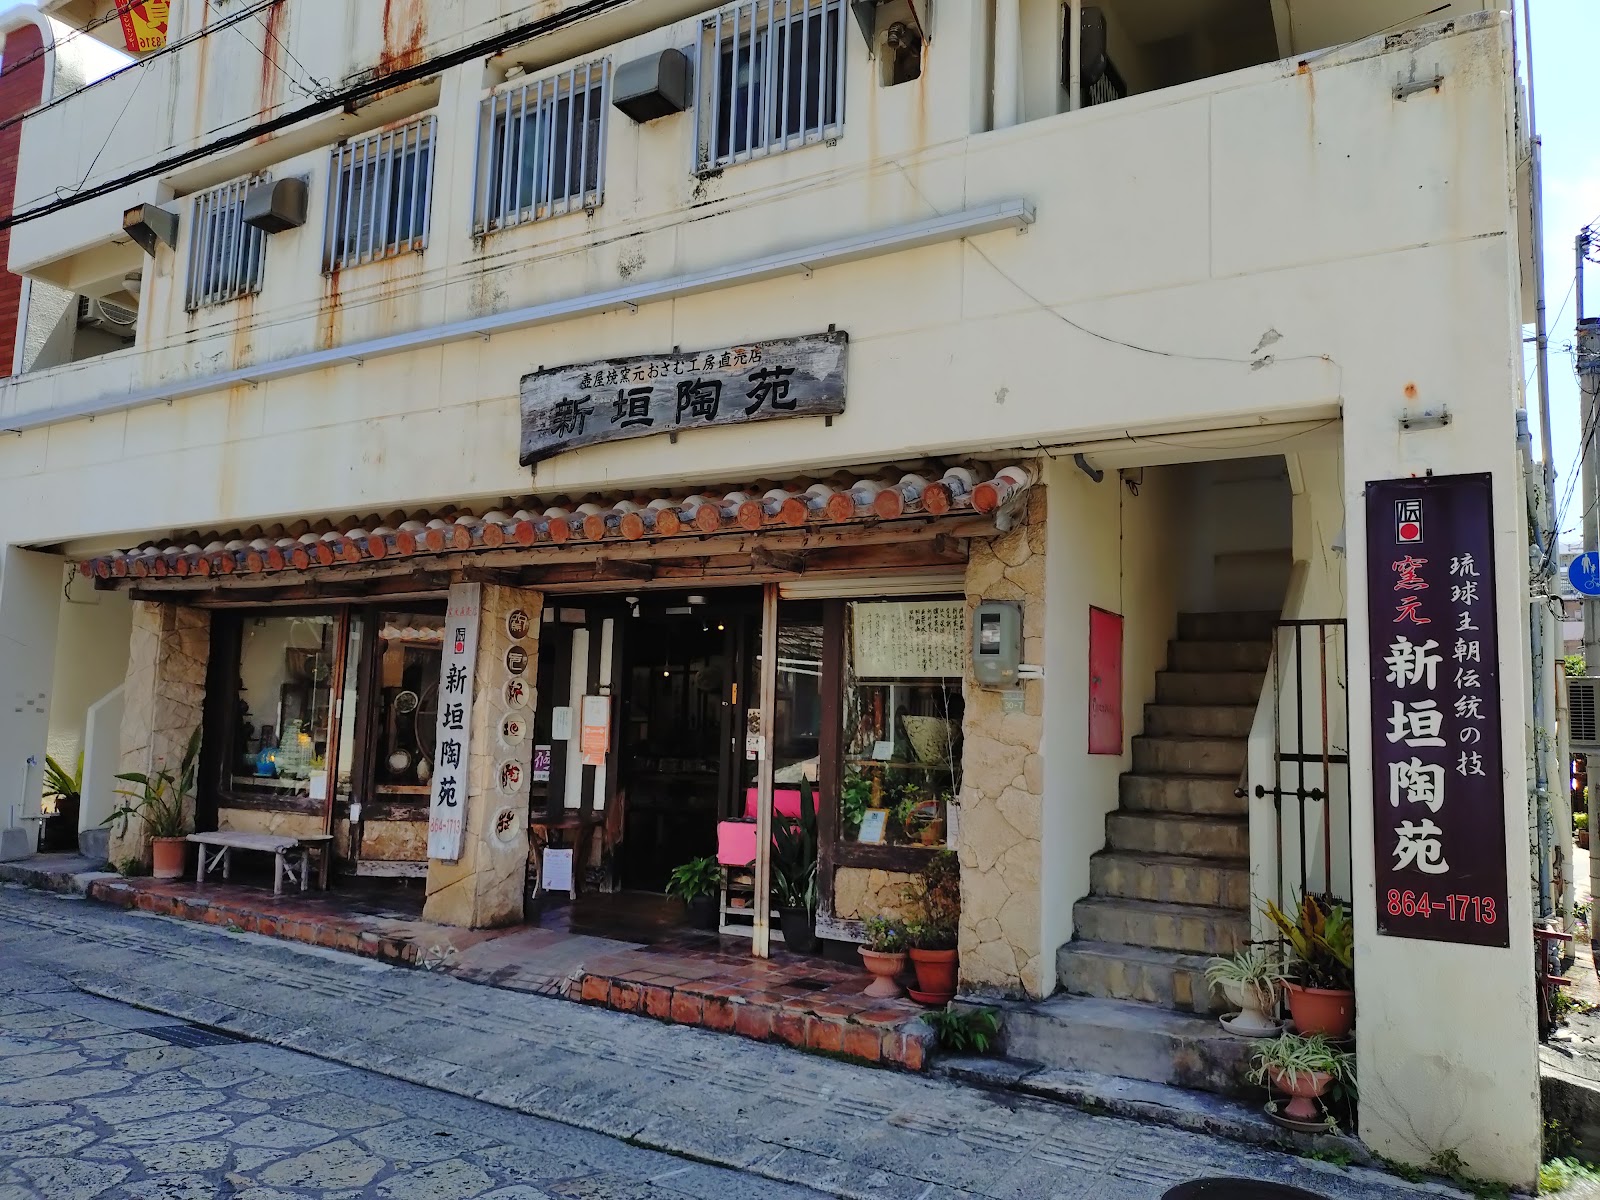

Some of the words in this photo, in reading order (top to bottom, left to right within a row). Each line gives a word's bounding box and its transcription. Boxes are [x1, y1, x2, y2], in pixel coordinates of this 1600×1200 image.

[550, 365, 798, 438] 新垣陶苑
[437, 663, 468, 808] 新垣陶苑
[1449, 552, 1486, 777] 琉球王朝伝統の技
[1383, 635, 1450, 875] 新垣陶苑
[1387, 889, 1497, 925] 864-1713
